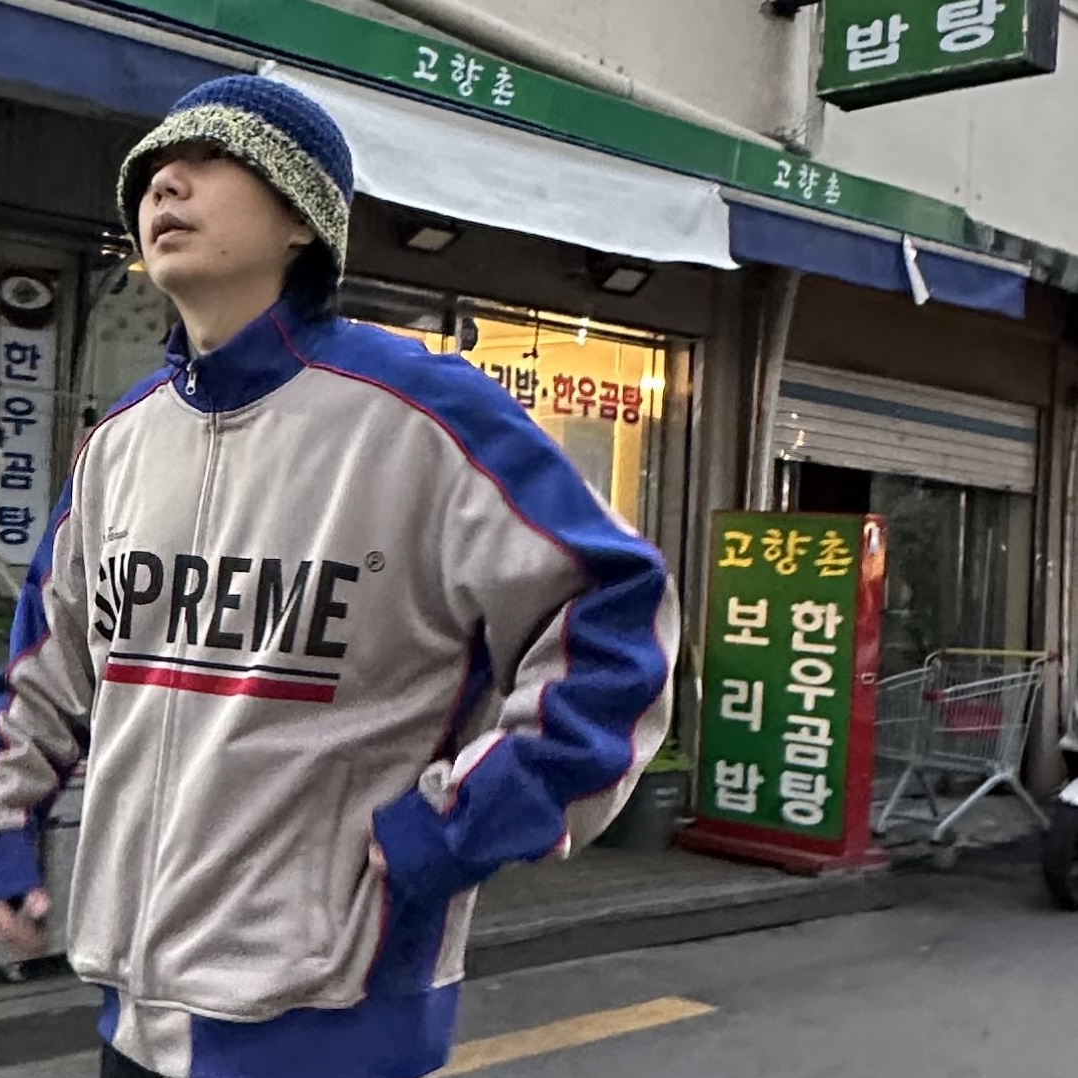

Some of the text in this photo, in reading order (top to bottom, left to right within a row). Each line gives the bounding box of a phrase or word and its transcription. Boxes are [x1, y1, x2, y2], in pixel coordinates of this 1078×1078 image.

[846, 14, 909, 71] 밥
[937, 0, 1005, 52] 탕
[413, 46, 515, 105] 고향촌
[773, 160, 841, 204] 고향촌
[553, 373, 642, 424] 한우곰탕
[718, 529, 853, 577] 고향촌
[715, 596, 770, 814] 보리밥
[780, 600, 843, 825] 한우곰탕
